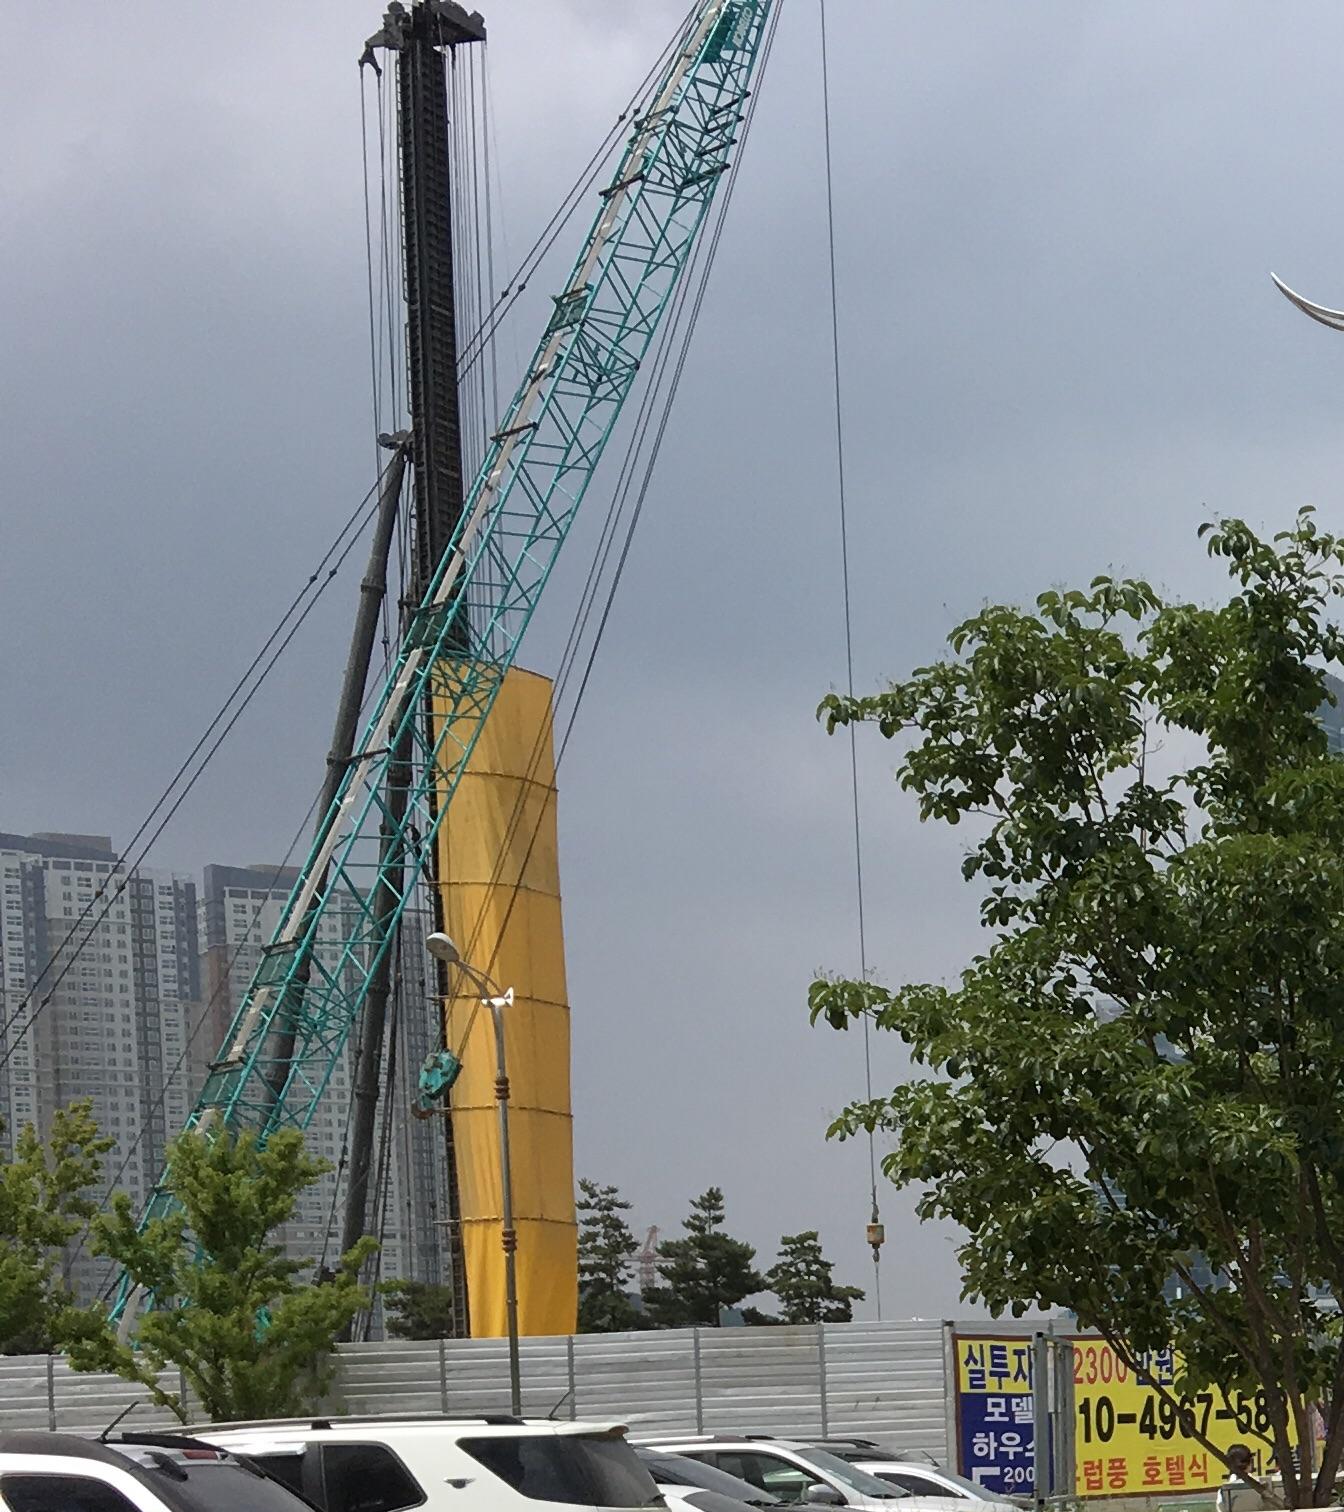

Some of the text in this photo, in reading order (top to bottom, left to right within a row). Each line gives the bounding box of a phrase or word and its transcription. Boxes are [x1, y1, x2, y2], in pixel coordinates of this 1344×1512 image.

[983, 1396, 1034, 1424] 모델
[1075, 1455, 1129, 1491] 럽풍
[1142, 1452, 1209, 1486] 호텔식
